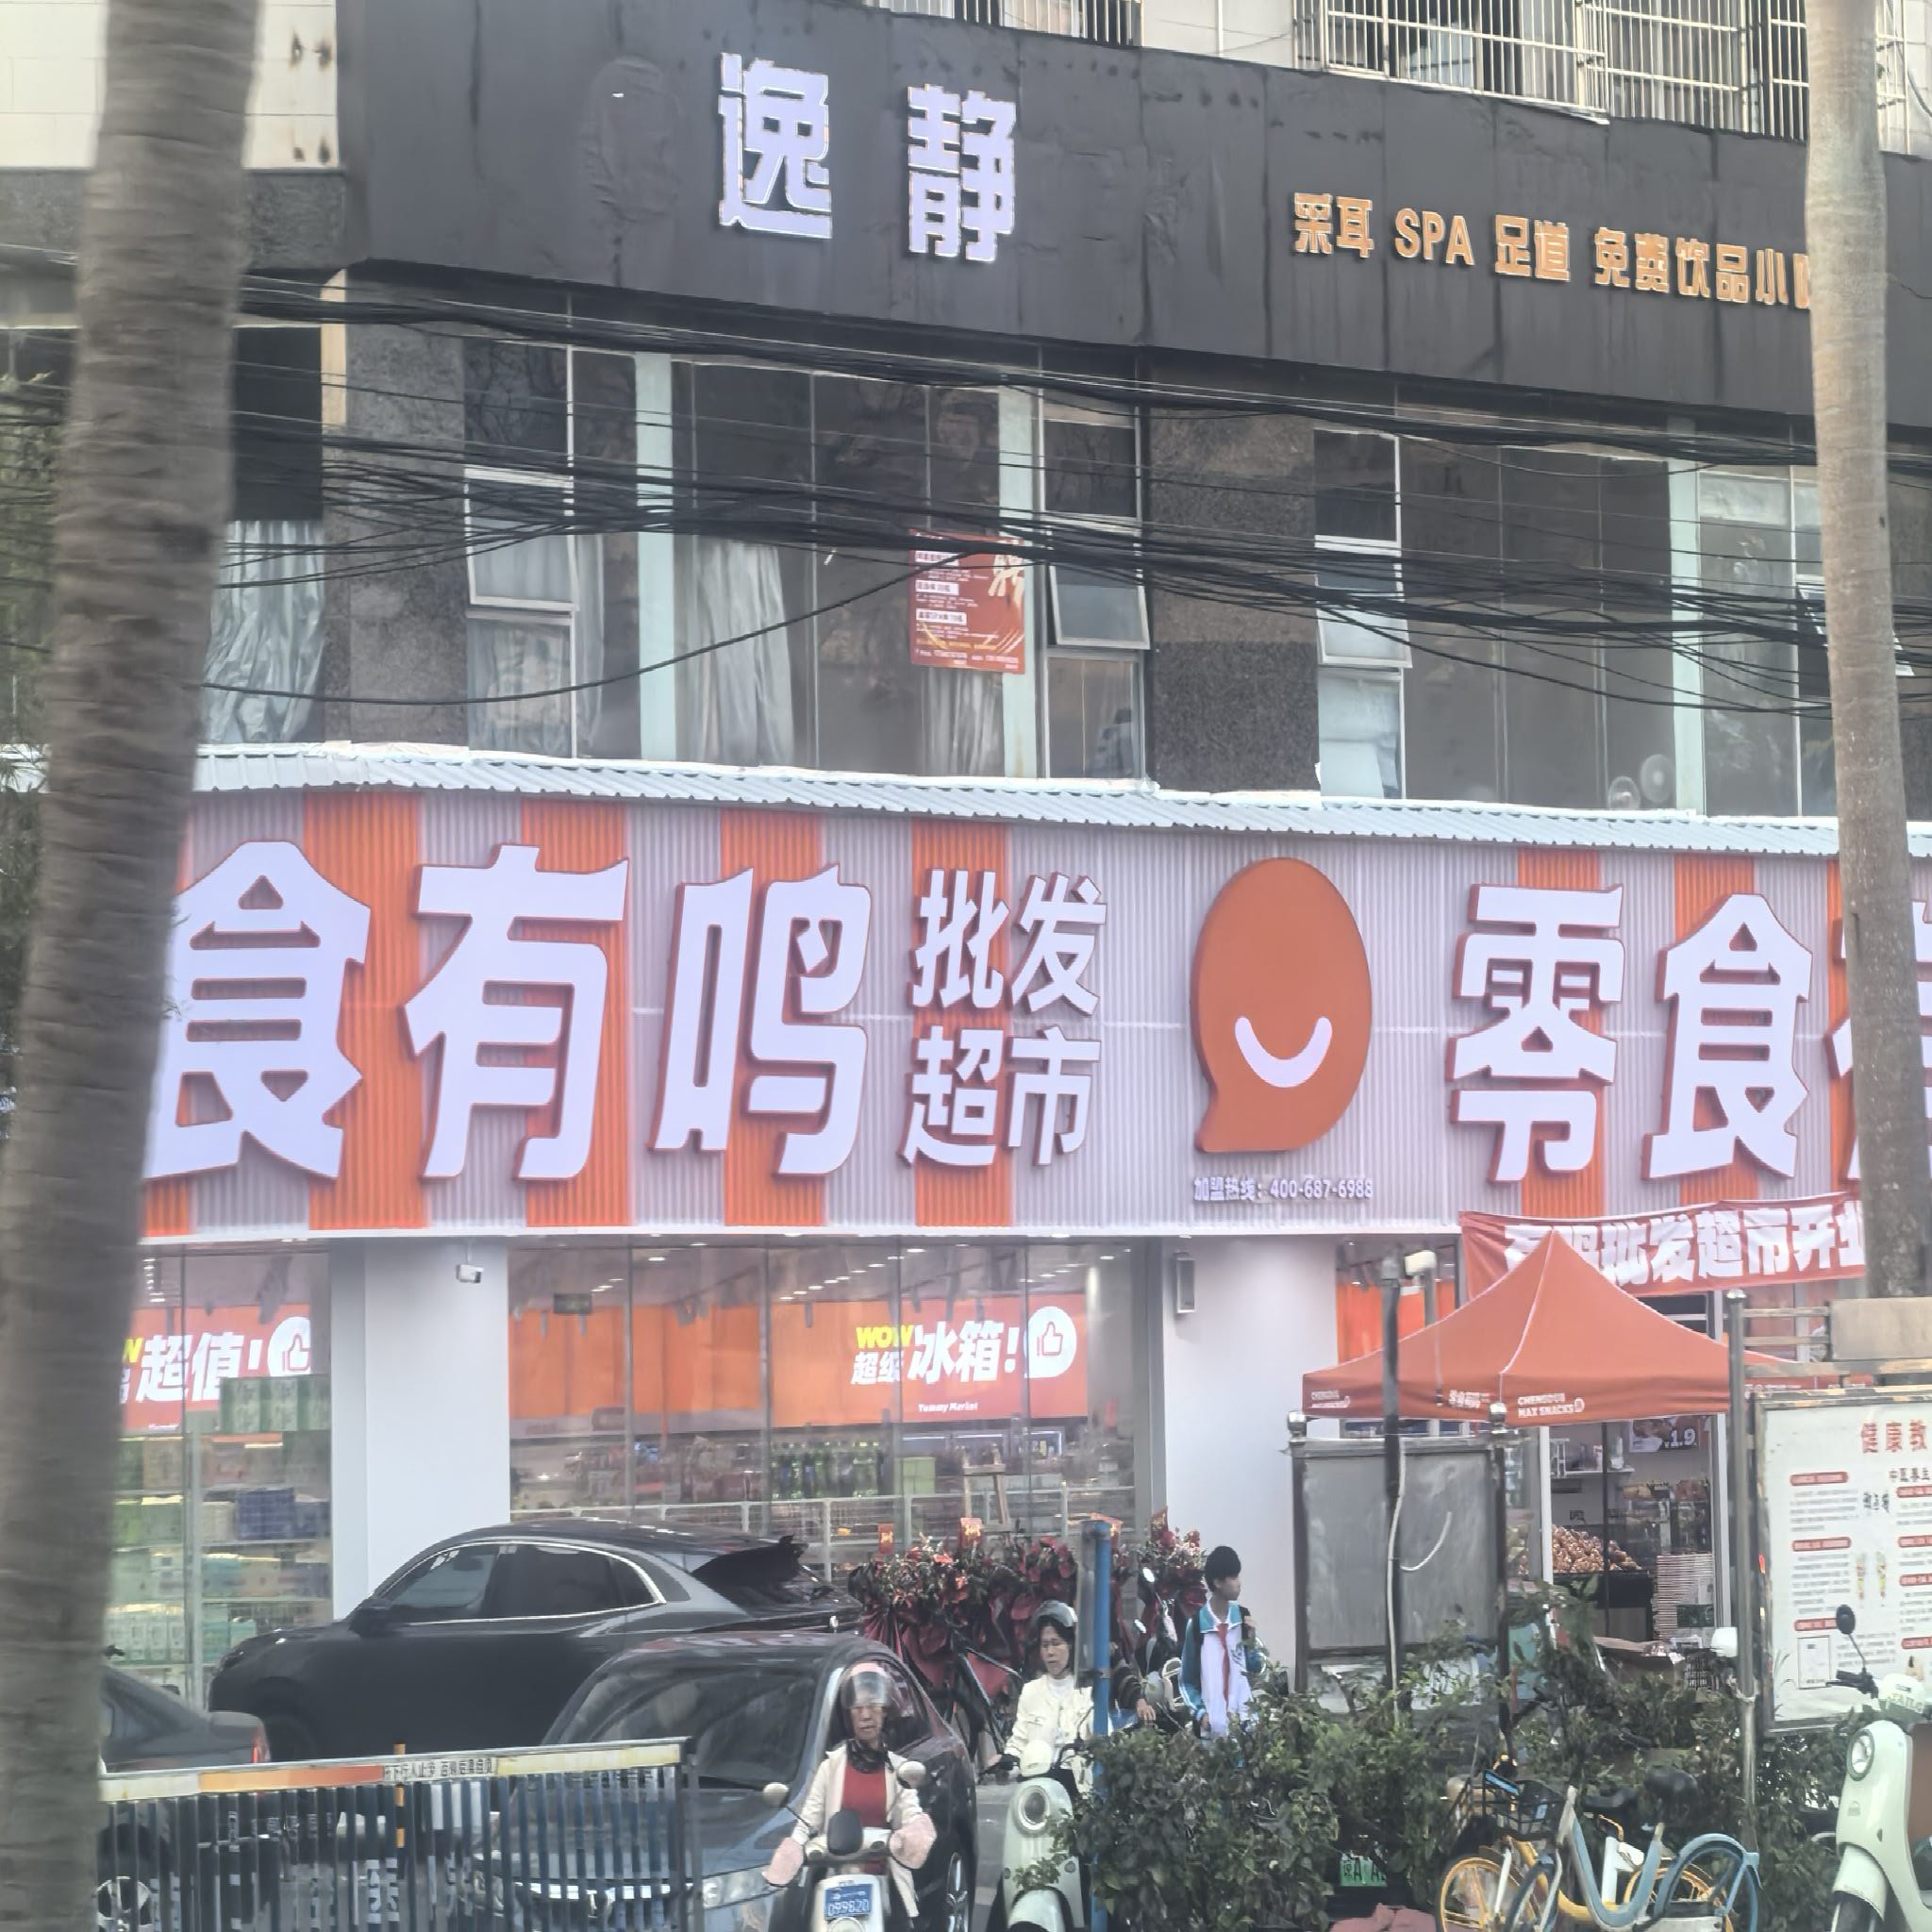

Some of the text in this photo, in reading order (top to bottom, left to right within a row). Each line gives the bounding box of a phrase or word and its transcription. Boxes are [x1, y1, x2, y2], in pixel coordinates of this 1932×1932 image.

[719, 52, 1017, 262] 逸静
[1293, 192, 1374, 258] 采耳
[1394, 207, 1475, 267] SPA
[1494, 213, 1572, 282] 足道
[913, 867, 1108, 1016] 批发
[1452, 883, 1932, 1181] 零食
[901, 1024, 1102, 1167] 超市
[850, 1351, 904, 1385] 超级
[856, 1324, 913, 1349] WOW
[907, 1320, 1021, 1384] 冰箱!
